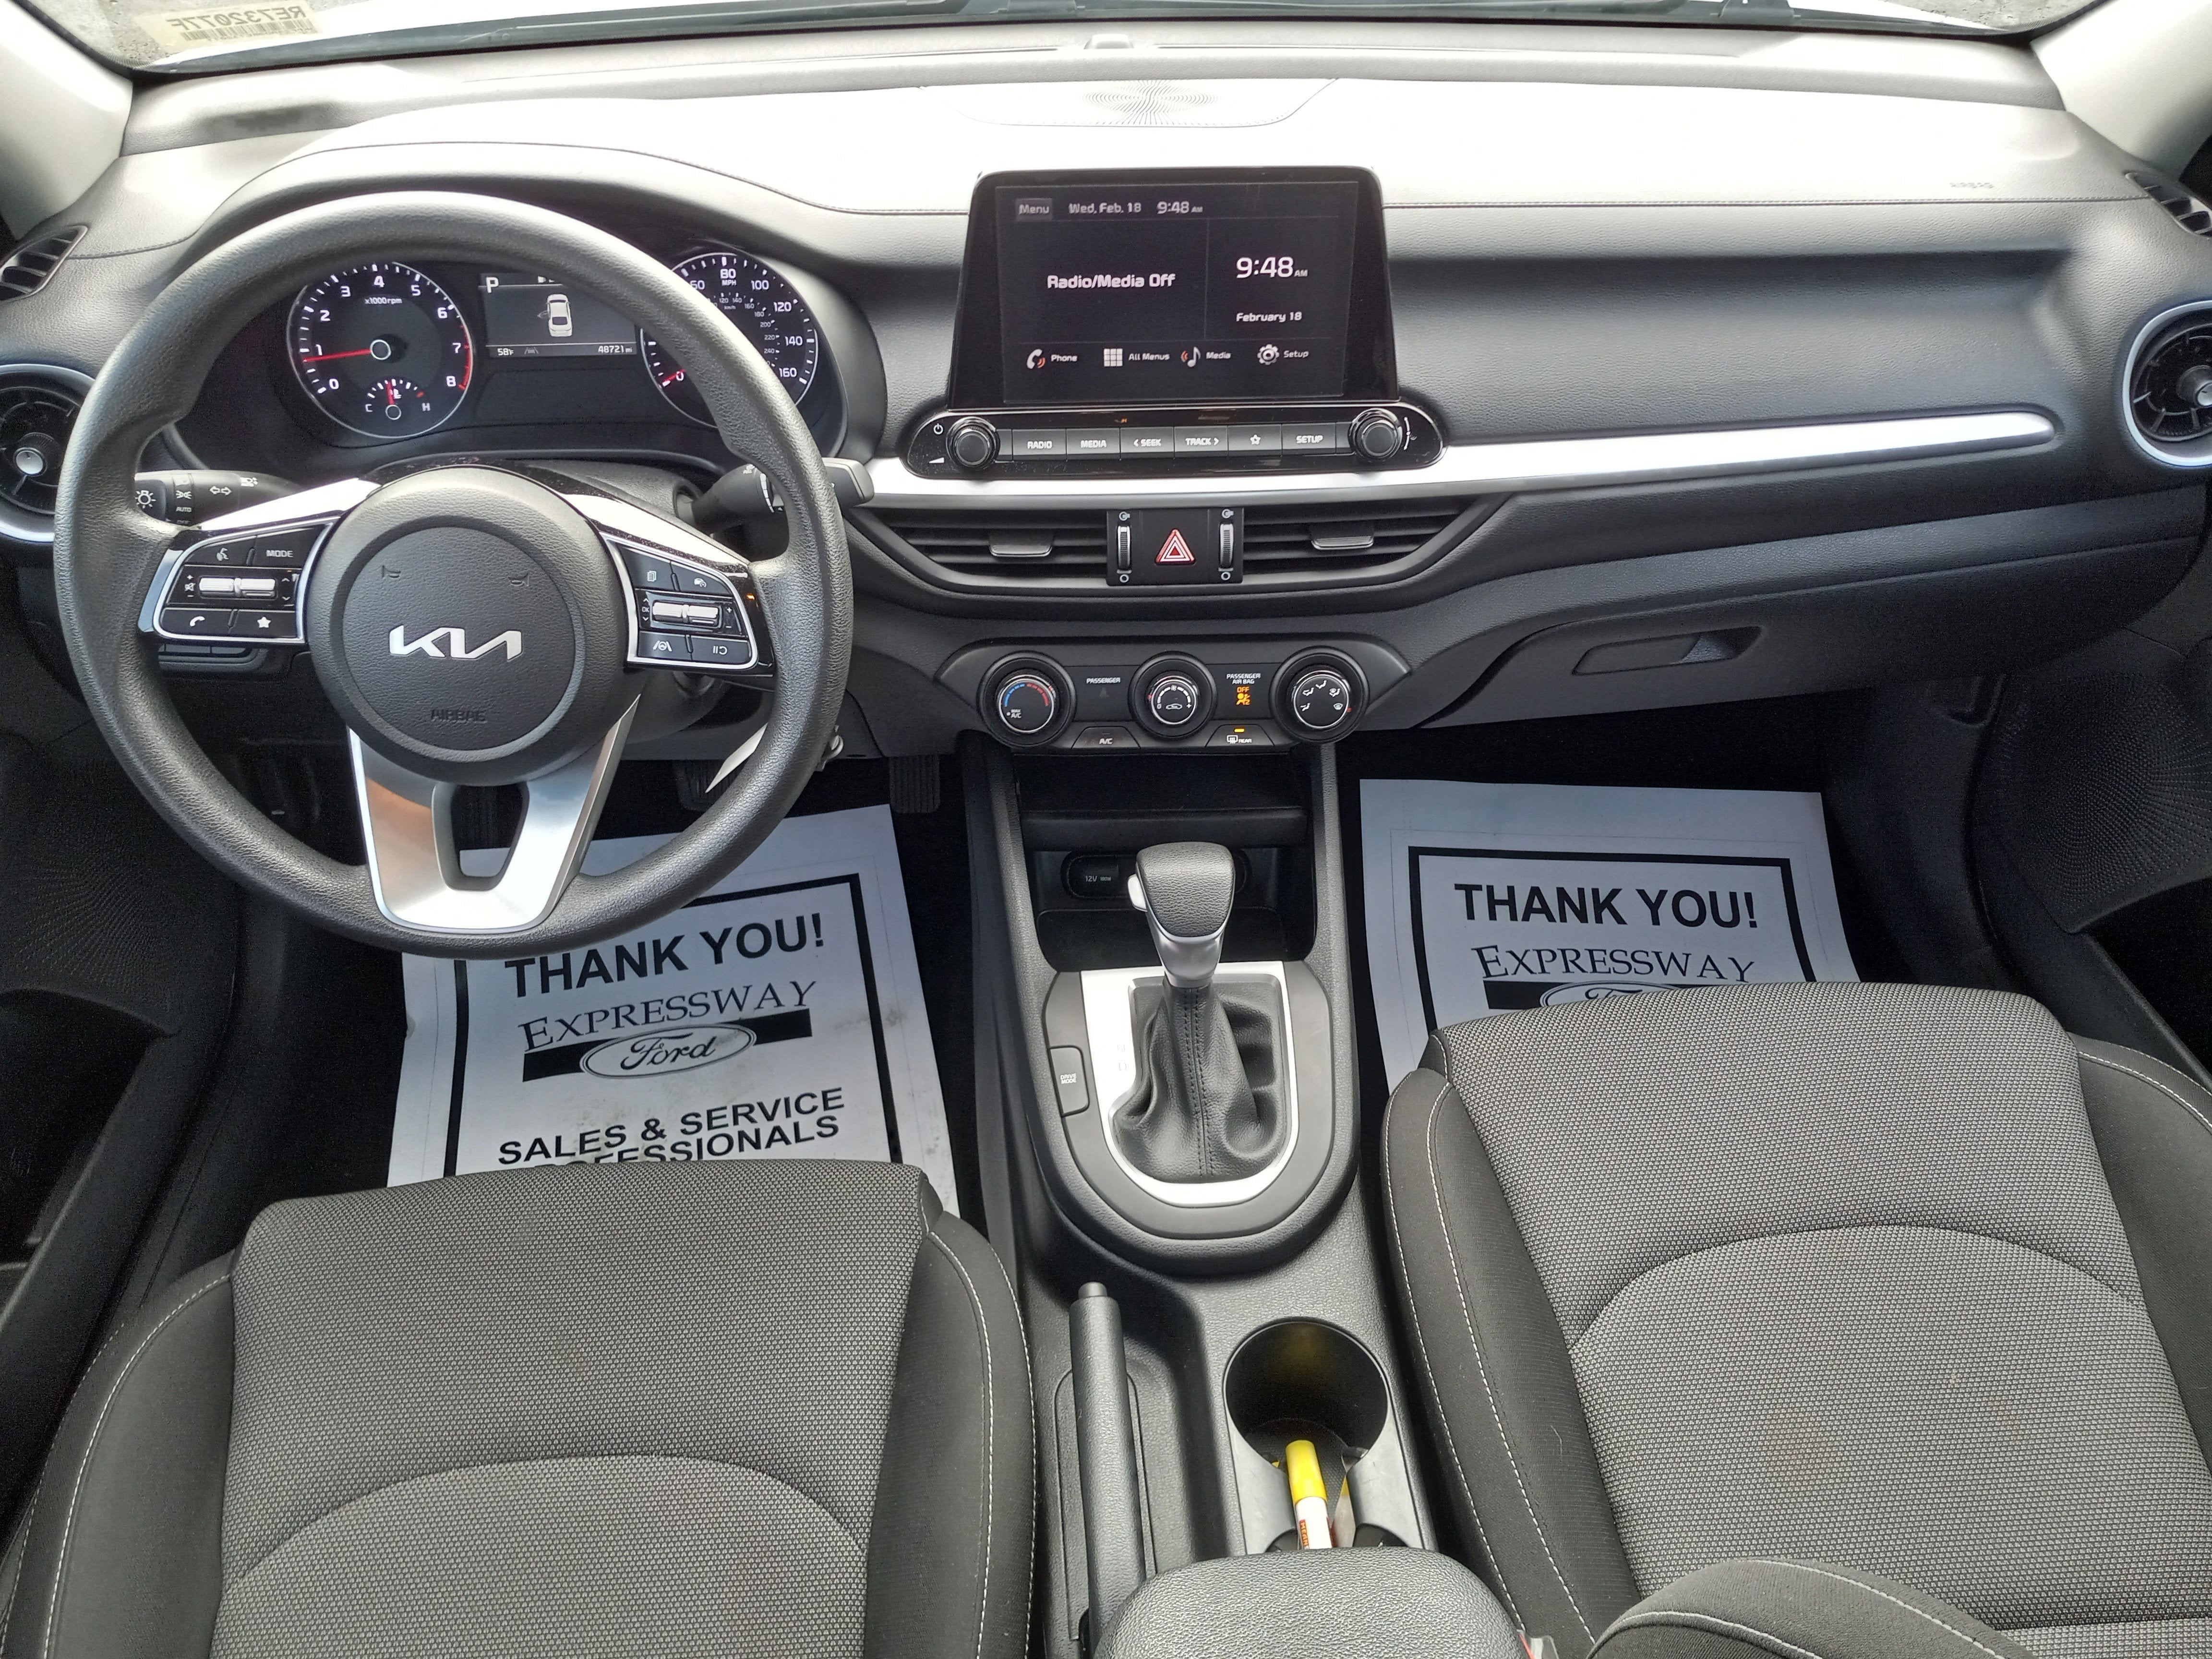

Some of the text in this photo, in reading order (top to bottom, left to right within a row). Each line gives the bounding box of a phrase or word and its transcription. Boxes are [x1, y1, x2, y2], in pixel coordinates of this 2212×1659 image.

[1018, 204, 1050, 214] Menu
[1099, 203, 1124, 214] Feb.
[1127, 202, 1142, 213] 18
[1156, 201, 1190, 214] 9:48
[1236, 256, 1294, 278] 9:48
[720, 268, 736, 279] 80
[373, 276, 385, 287] 4
[486, 277, 499, 293] P
[751, 280, 769, 290] 100
[1047, 273, 1176, 289] Radio/Media Off
[341, 286, 351, 297] 3
[411, 285, 421, 296] 5
[773, 301, 792, 313] 120
[320, 310, 330, 321] 2
[437, 307, 447, 319] 6
[1236, 311, 1302, 323] February 18
[784, 336, 803, 346] 140
[316, 344, 323, 355] 1
[452, 342, 461, 354] 7
[598, 345, 624, 354] 48721
[779, 367, 797, 377] 160
[329, 379, 339, 390] 0
[446, 376, 457, 387] 8
[365, 404, 373, 412] C
[422, 403, 431, 411] H
[1027, 441, 1053, 449] RADIO
[1081, 440, 1107, 448] MEDIA
[1141, 438, 1162, 447] SEEK
[1185, 437, 1212, 446] TRACK
[1296, 435, 1323, 444] SETUP
[266, 549, 293, 558] MODE
[389, 625, 523, 660] KIA
[1455, 883, 1757, 928] THANK YOU!
[505, 913, 824, 998] THANK YOU!
[1471, 944, 1755, 983] EXPRESSWAY
[518, 981, 817, 1051] EXPRESSWAY
[619, 1034, 719, 1072] Ford
[498, 1087, 845, 1165] SALES & SERVICE
